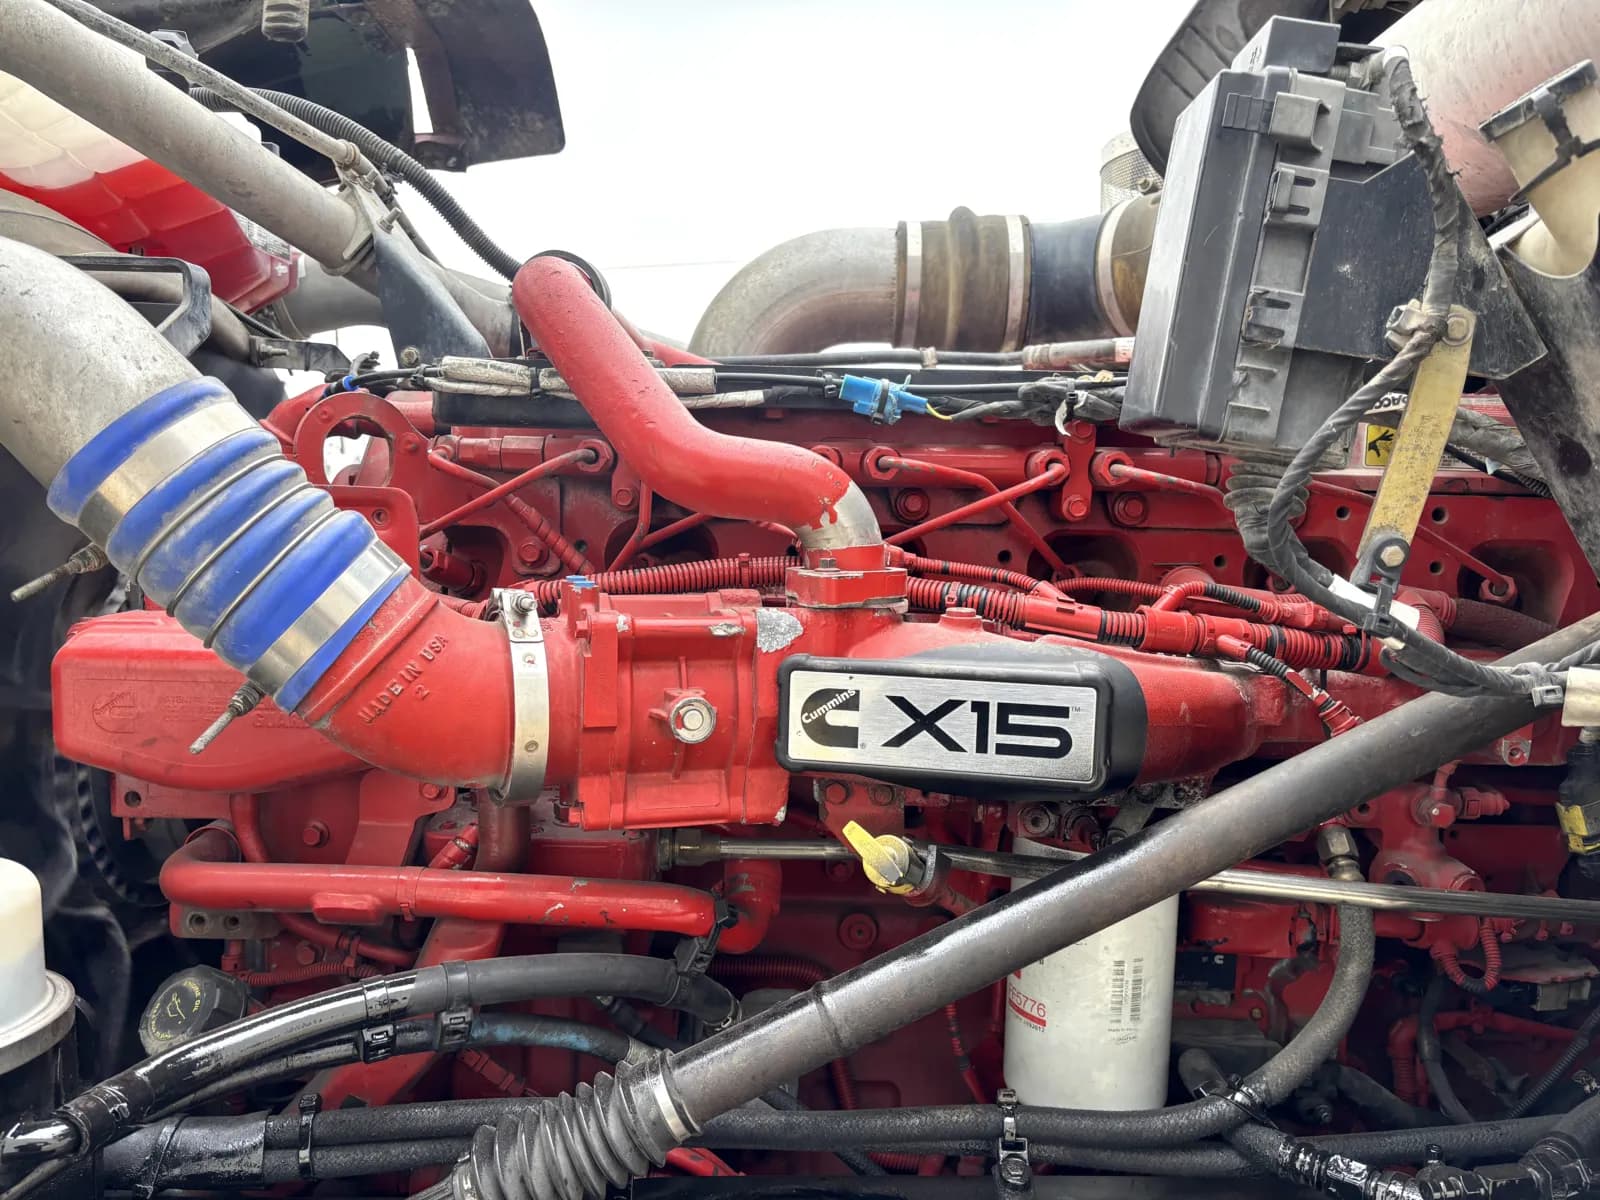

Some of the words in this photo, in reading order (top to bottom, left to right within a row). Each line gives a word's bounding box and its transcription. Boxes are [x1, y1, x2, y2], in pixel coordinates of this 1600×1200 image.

[358, 679, 405, 724] MADE
[399, 660, 423, 683] IN
[419, 634, 449, 661] USA
[801, 687, 857, 724] Cummins
[881, 694, 1073, 759] X15
